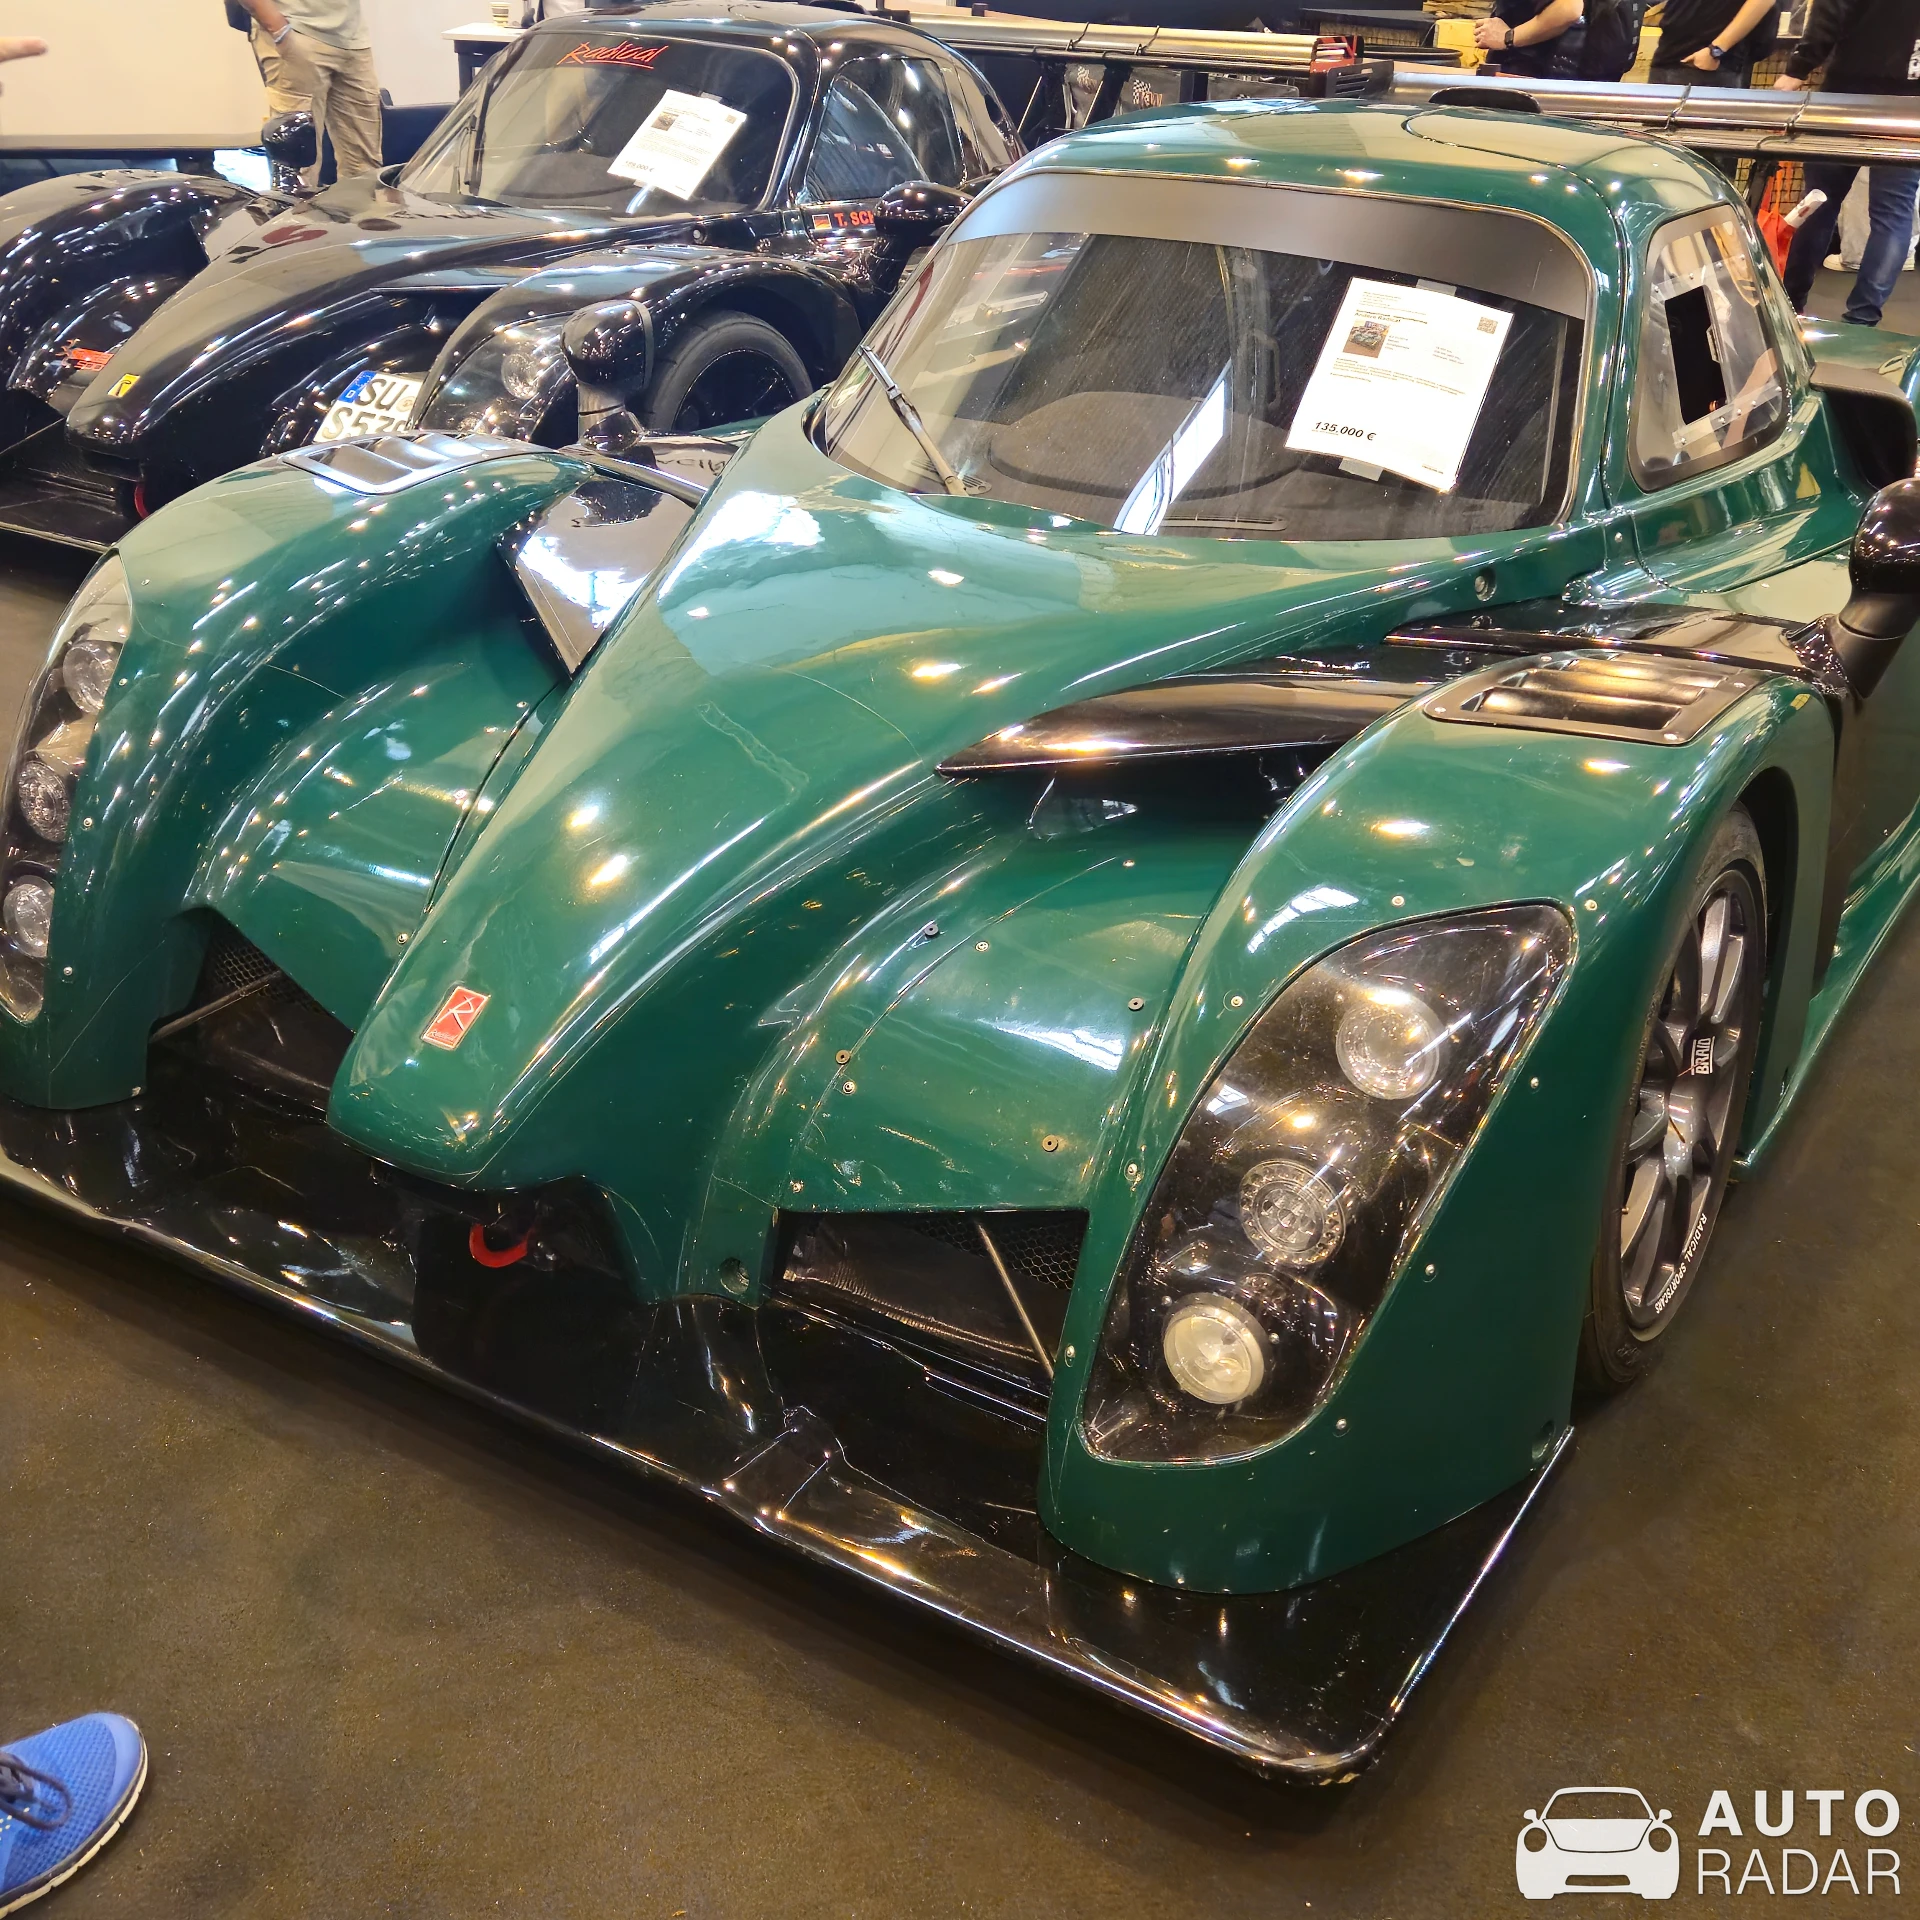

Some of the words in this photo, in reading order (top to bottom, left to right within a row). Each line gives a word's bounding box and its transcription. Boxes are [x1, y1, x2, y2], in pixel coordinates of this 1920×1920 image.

[557, 41, 668, 67] Radical
[834, 212, 848, 227] T.
[354, 378, 409, 411] SU
[1315, 421, 1364, 438] 135.000
[1367, 432, 1377, 441] €
[437, 995, 476, 1031] R
[1695, 1037, 1712, 1075] BRAID
[1685, 1212, 1708, 1264] RADICAL
[1654, 1261, 1687, 1315] SPORTSCARS
